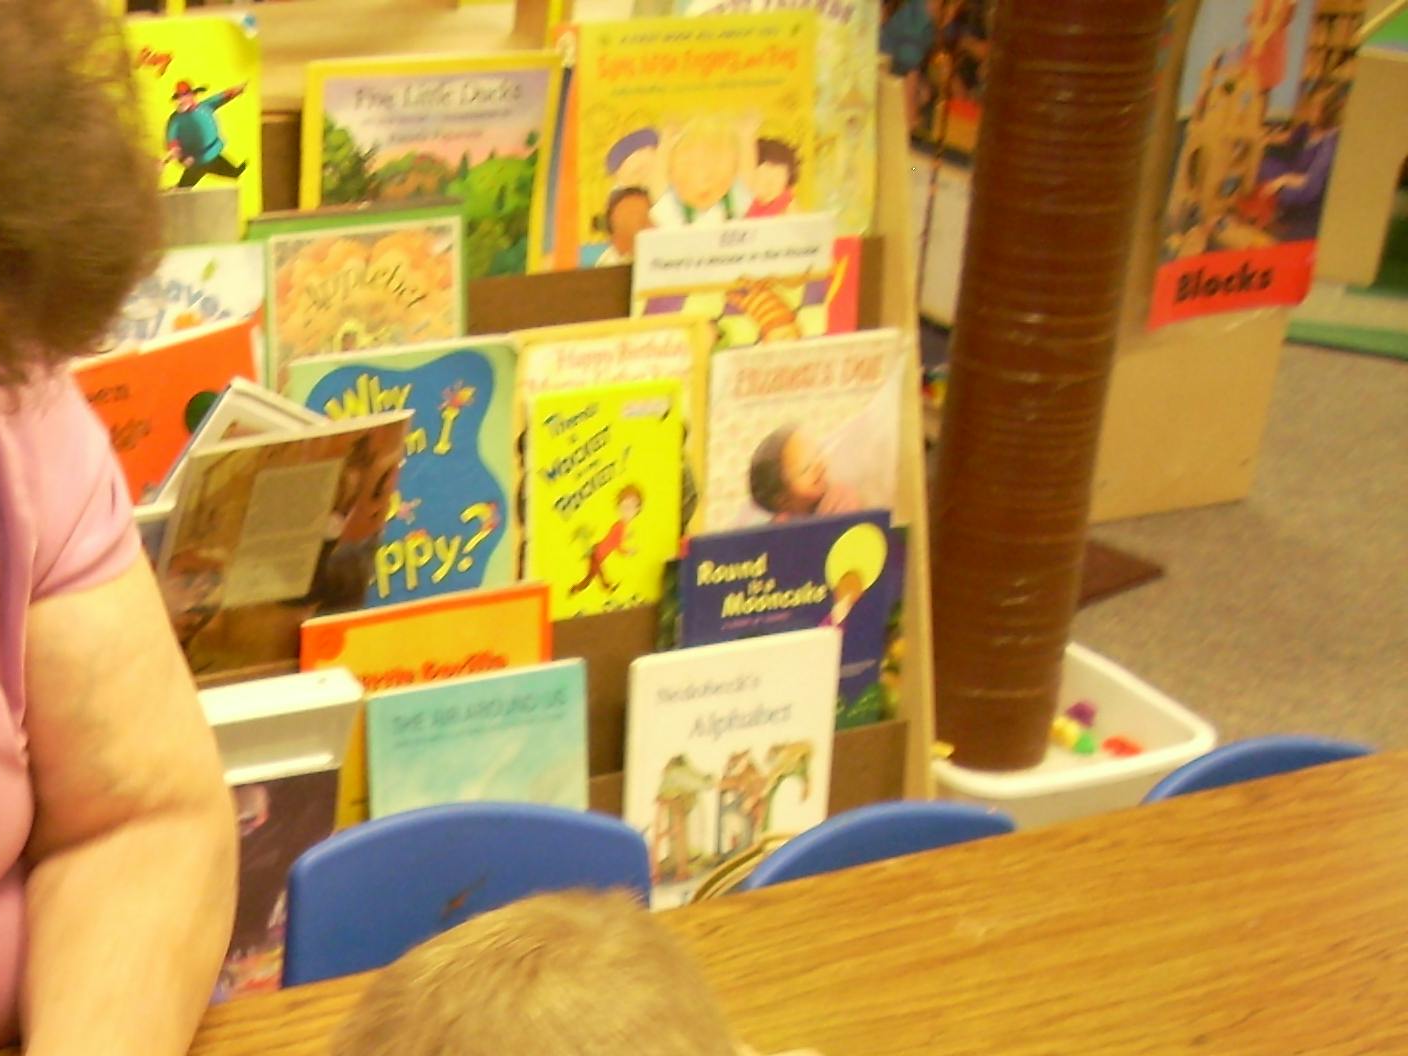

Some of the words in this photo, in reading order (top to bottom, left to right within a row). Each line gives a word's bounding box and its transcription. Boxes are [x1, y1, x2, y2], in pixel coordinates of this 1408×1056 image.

[1175, 260, 1273, 302] Blocks
[697, 551, 769, 587] Round
[721, 581, 830, 618] Mooncake
[688, 703, 793, 742] Alphabet
